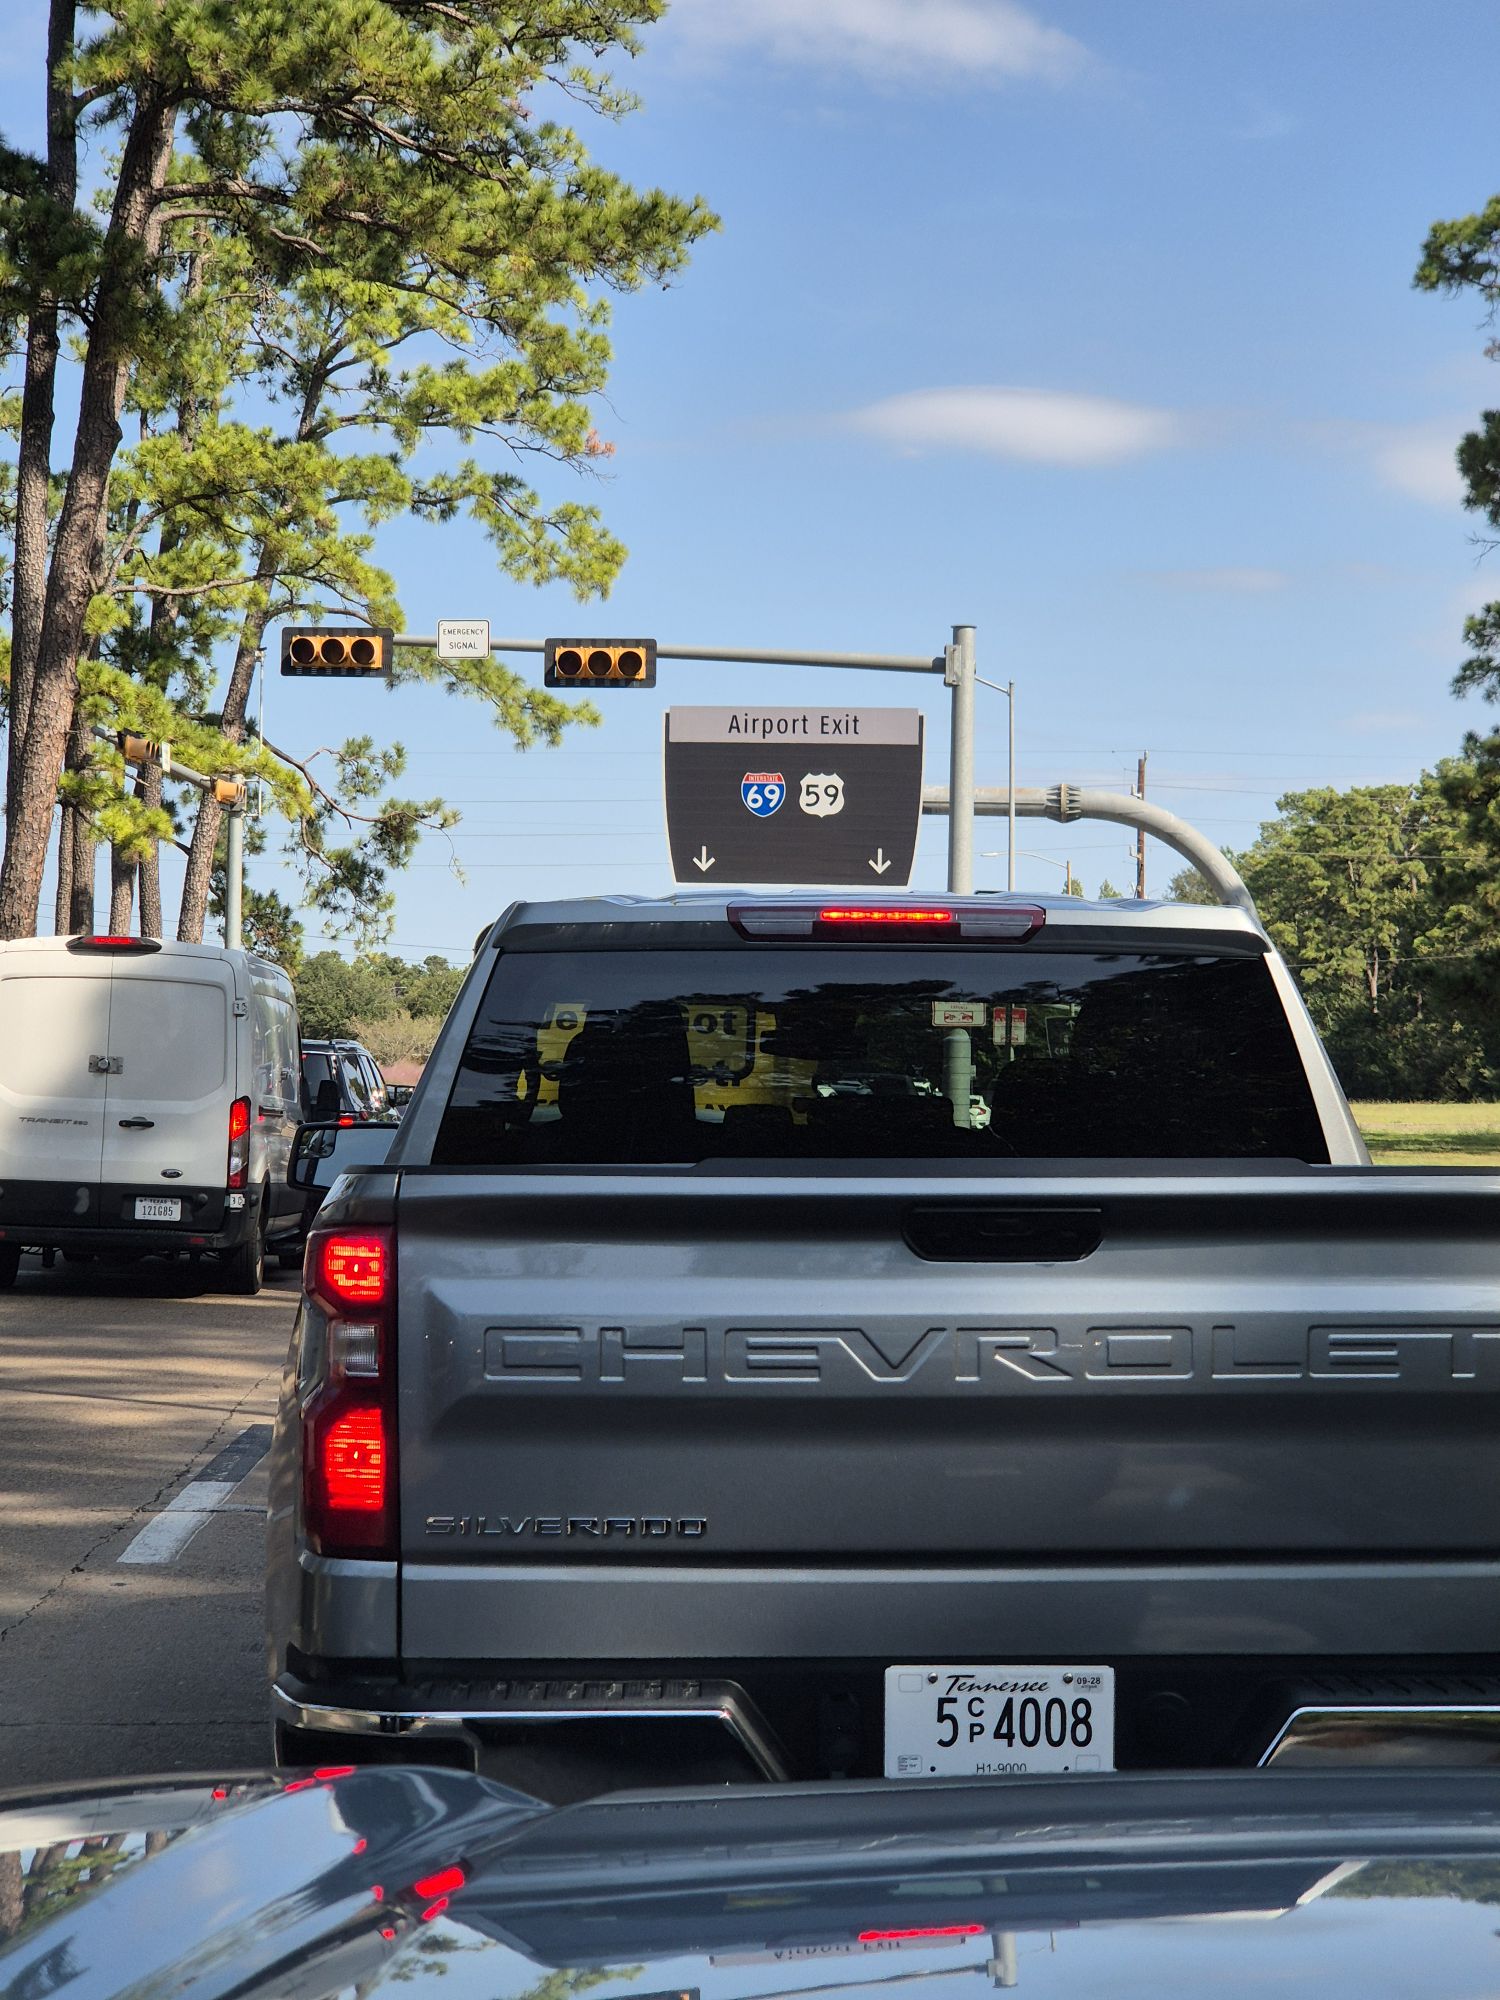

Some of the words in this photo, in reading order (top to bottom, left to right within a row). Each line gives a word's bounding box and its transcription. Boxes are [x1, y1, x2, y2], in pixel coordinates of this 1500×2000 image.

[443, 628, 484, 636] EMERGENCY
[449, 641, 478, 650] SIGNAL
[728, 713, 809, 739] Airport
[820, 715, 860, 735] Exit
[747, 784, 780, 808] 69
[805, 784, 839, 807] 59
[19, 1116, 73, 1125] TRANSIT
[484, 1325, 1500, 1383] CHEVROLET
[425, 1516, 708, 1536] SILVERADO
[945, 1674, 1050, 1696] Tennessee
[993, 1697, 1093, 1748] 4008
